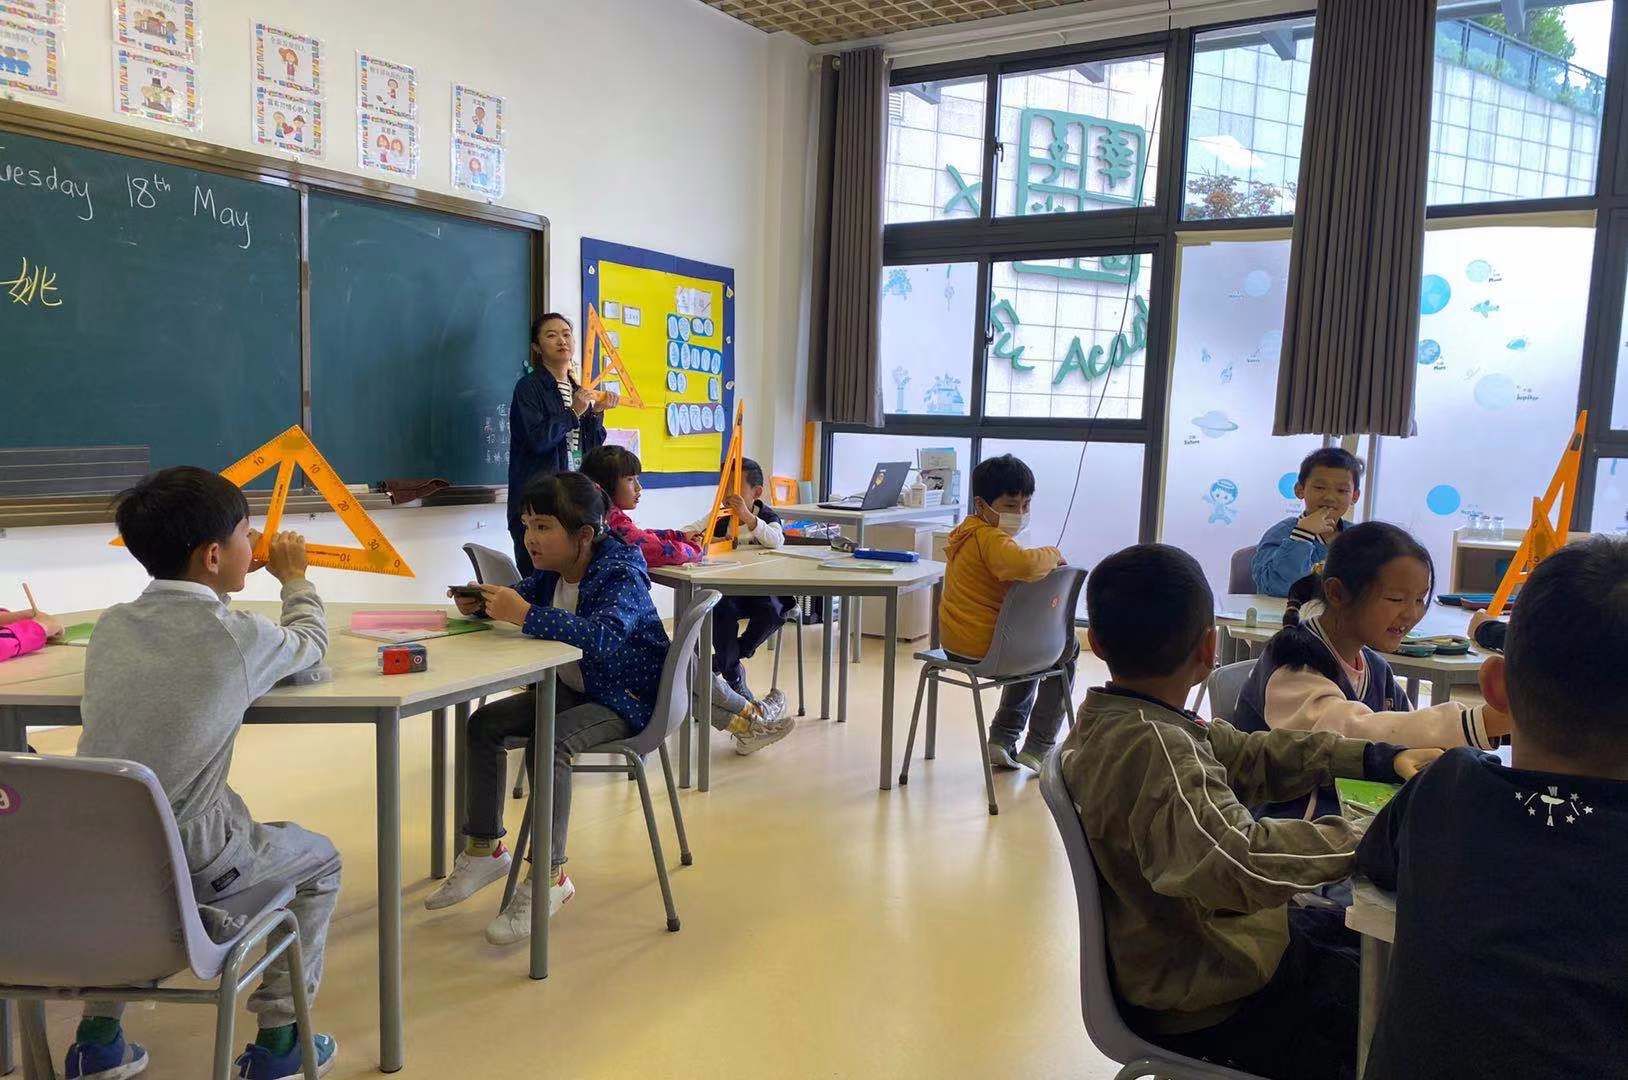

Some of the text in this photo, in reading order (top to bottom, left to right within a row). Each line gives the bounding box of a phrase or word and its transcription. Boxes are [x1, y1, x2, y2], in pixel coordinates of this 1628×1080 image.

[0, 146, 93, 221] uesday
[193, 185, 251, 249] May
[253, 456, 265, 467] 10
[337, 500, 351, 512] 20
